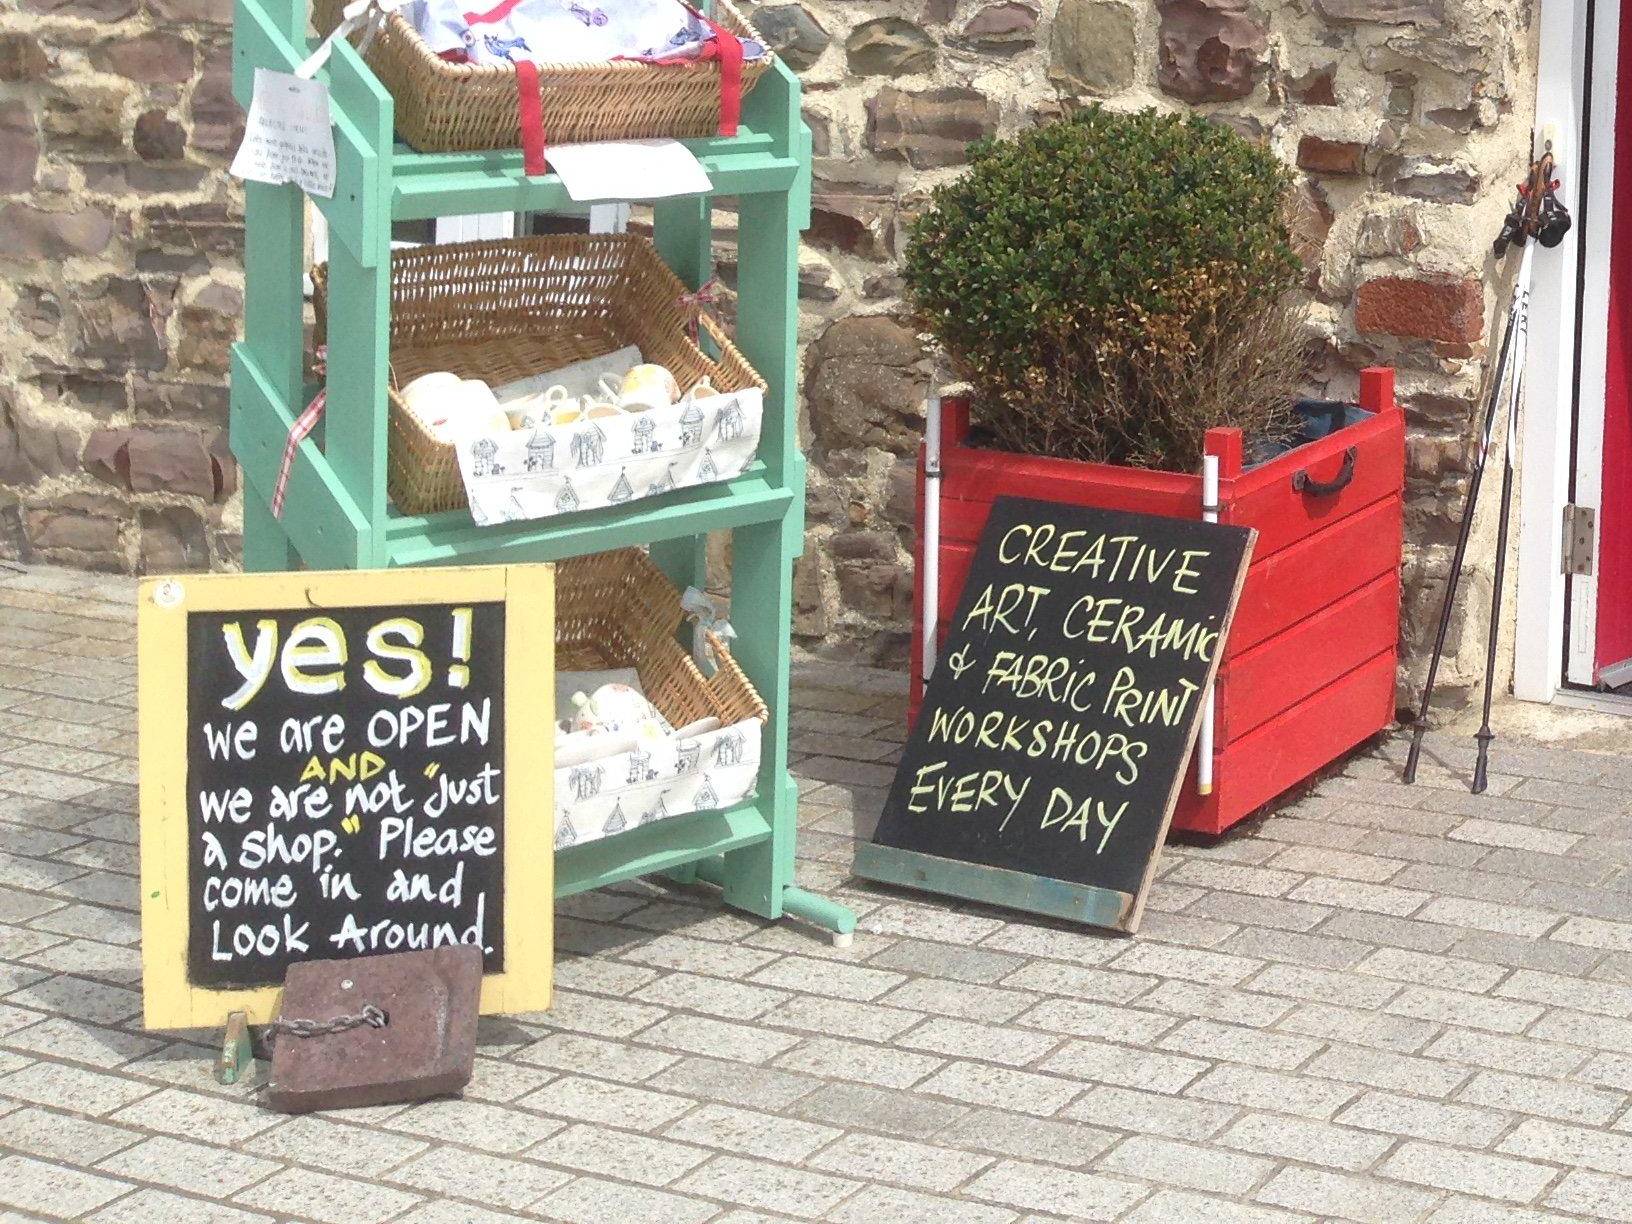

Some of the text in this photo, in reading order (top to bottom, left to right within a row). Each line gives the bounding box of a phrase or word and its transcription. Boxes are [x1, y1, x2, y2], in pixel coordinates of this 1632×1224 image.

[998, 524, 1211, 594] CREATIVE
[962, 583, 1218, 663] ART, CERAMIC
[982, 651, 1096, 713] FABRIC
[1102, 666, 1200, 727] PRINT
[280, 713, 346, 754] are
[367, 698, 491, 749] OPEN
[928, 706, 1147, 786] WORKSHOPS
[270, 783, 333, 818] are
[346, 770, 413, 815] not
[300, 752, 385, 784] AND
[908, 761, 1129, 855] EVERY DAY
[202, 832, 227, 871] a
[379, 817, 496, 859] Please
[203, 861, 464, 911] come in and
[212, 914, 309, 961] Look
